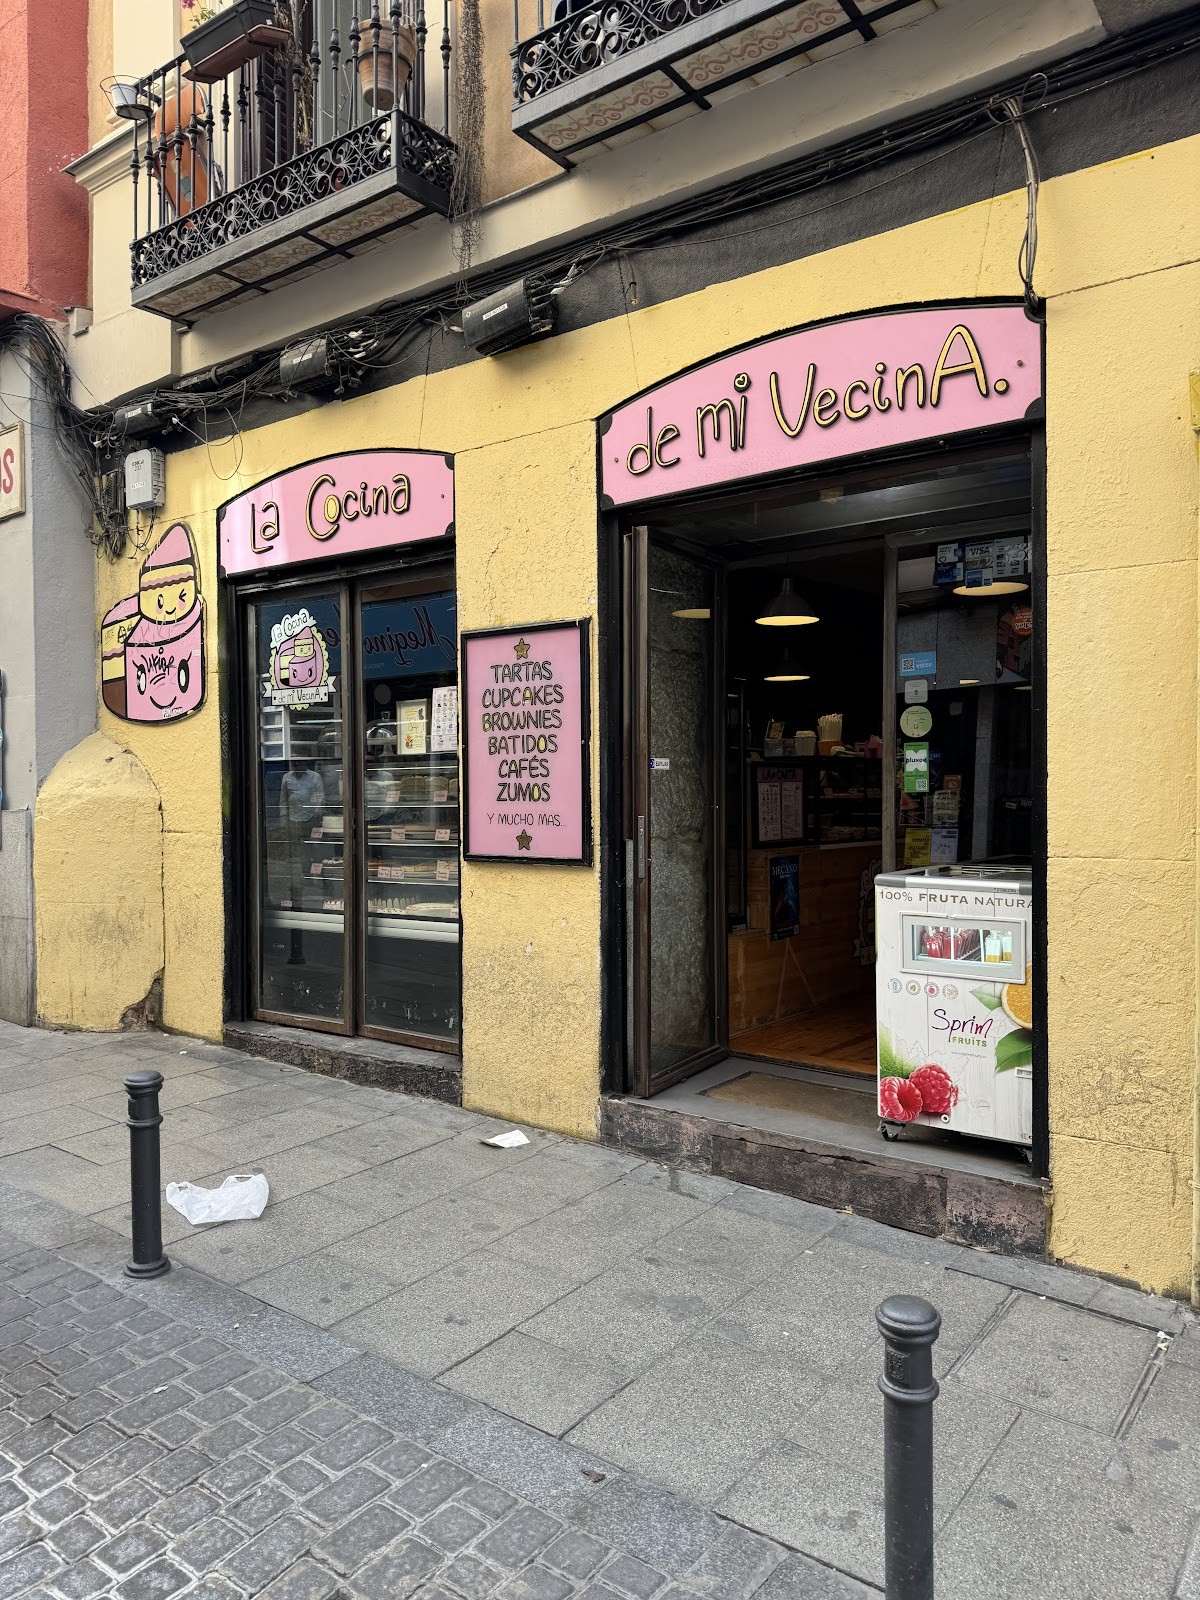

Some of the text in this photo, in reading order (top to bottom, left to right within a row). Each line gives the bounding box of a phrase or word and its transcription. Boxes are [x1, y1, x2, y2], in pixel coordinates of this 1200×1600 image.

[626, 406, 680, 475] de
[696, 371, 752, 457] mi
[0, 448, 15, 494] S
[250, 473, 411, 554] La Cocina
[970, 546, 990, 556] VISA
[272, 626, 284, 643] La
[283, 612, 309, 637] Cocina
[490, 660, 553, 684] TARTAS
[481, 684, 565, 709] CUPCAKES
[482, 709, 563, 733] BROWNIES
[487, 733, 559, 756] BATIDOS
[498, 755, 550, 779] CAFÉS
[496, 782, 551, 803] ZUMOS
[486, 812, 495, 826] Y
[497, 813, 534, 826] MUCHO
[879, 890, 914, 902] 100%
[918, 893, 969, 905] FRUTA
[931, 1008, 994, 1043] Sprim
